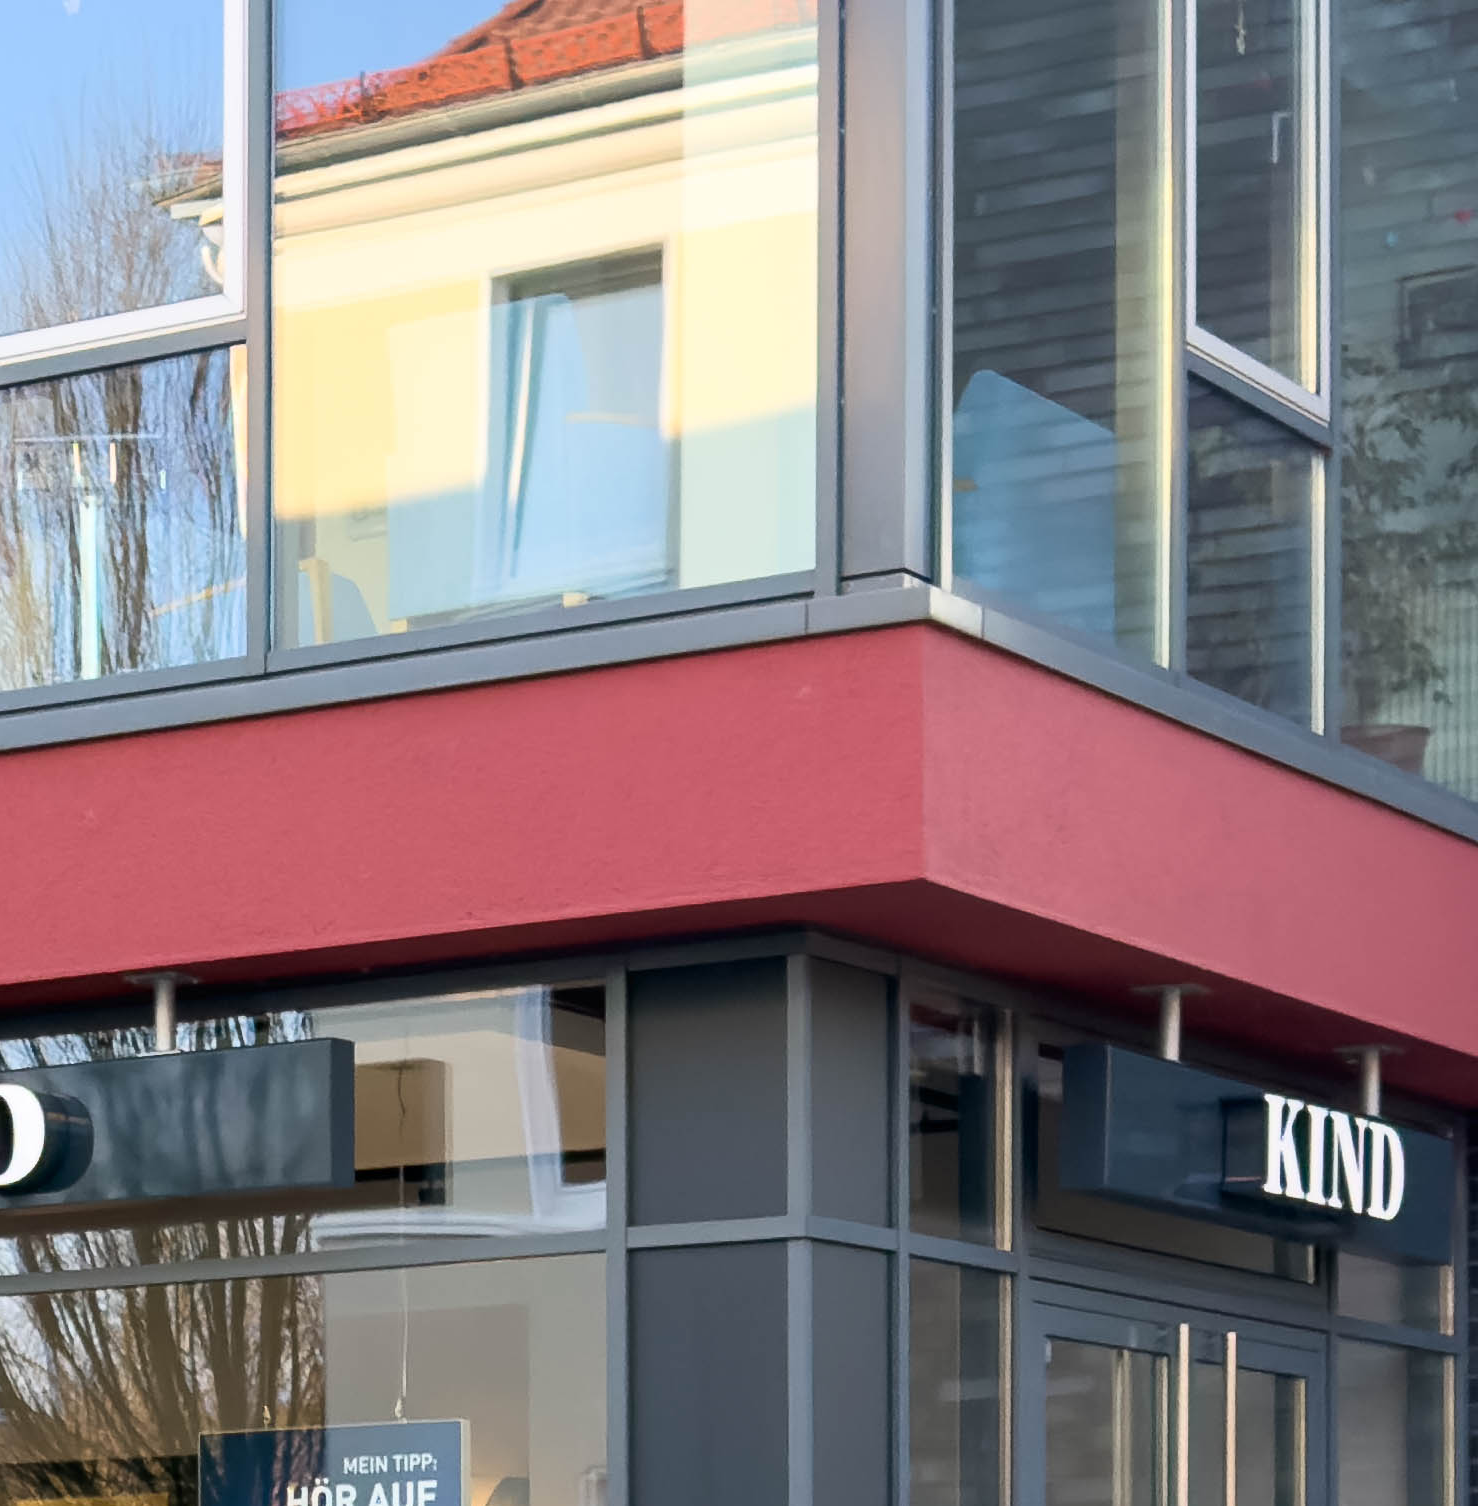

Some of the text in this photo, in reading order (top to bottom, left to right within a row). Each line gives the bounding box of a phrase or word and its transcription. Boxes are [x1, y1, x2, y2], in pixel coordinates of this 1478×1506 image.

[1263, 1093, 1405, 1222] KIND
[342, 1453, 438, 1475] MEIN TIPP:
